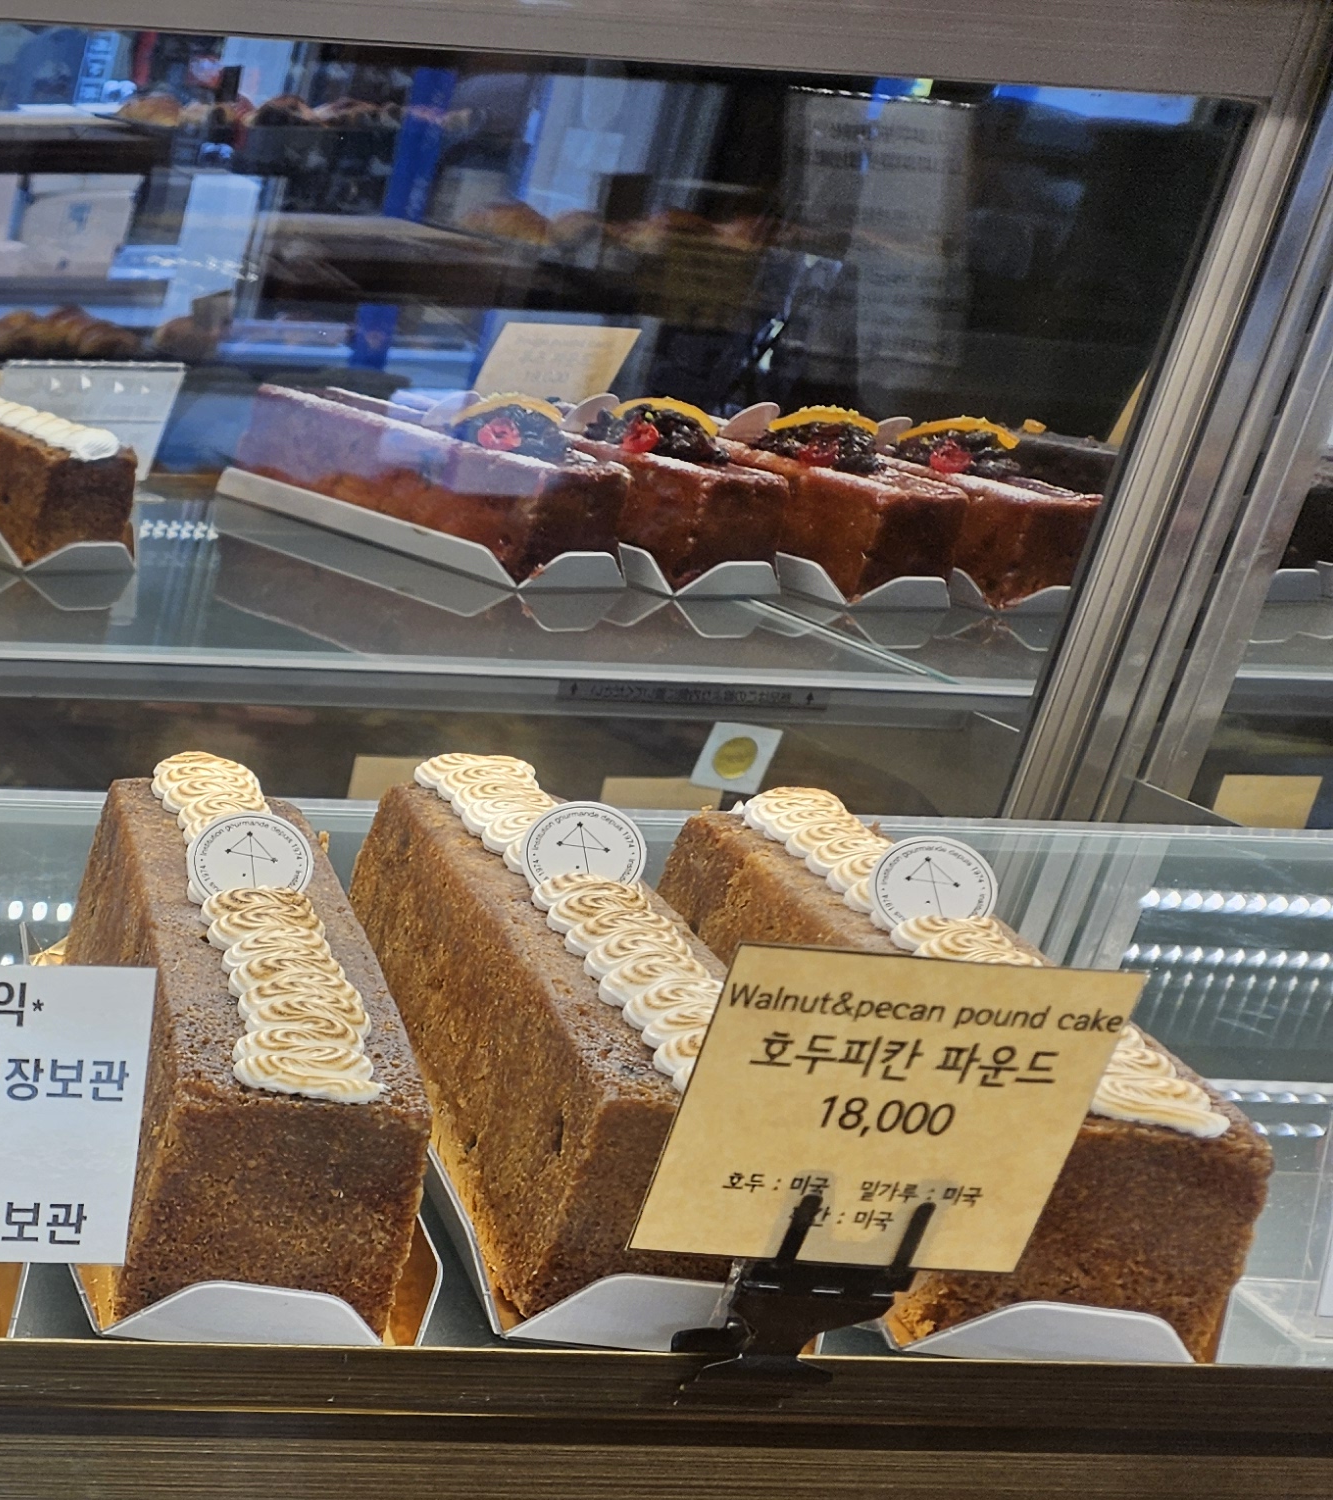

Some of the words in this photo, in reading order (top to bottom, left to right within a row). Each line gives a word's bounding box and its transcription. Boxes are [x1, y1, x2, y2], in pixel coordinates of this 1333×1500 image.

[225, 821, 269, 832] gourmande
[271, 826, 293, 843] depuis
[292, 843, 303, 860] 1974
[555, 811, 600, 824] gourmande
[601, 815, 623, 832] depuis
[622, 831, 635, 848] 1974
[729, 982, 946, 1024] Walnut&pecan
[954, 1005, 1050, 1031] pound
[1057, 1009, 1124, 1034] cake
[749, 1030, 924, 1083] 호두피칸
[935, 1043, 1061, 1088] 파운드
[818, 1095, 956, 1138] 18,000
[722, 1171, 766, 1193] 호두
[789, 1175, 830, 1196] 미국
[859, 1180, 919, 1203] 밀가루
[942, 1184, 983, 1208] 미국
[853, 1208, 894, 1232] 미국
